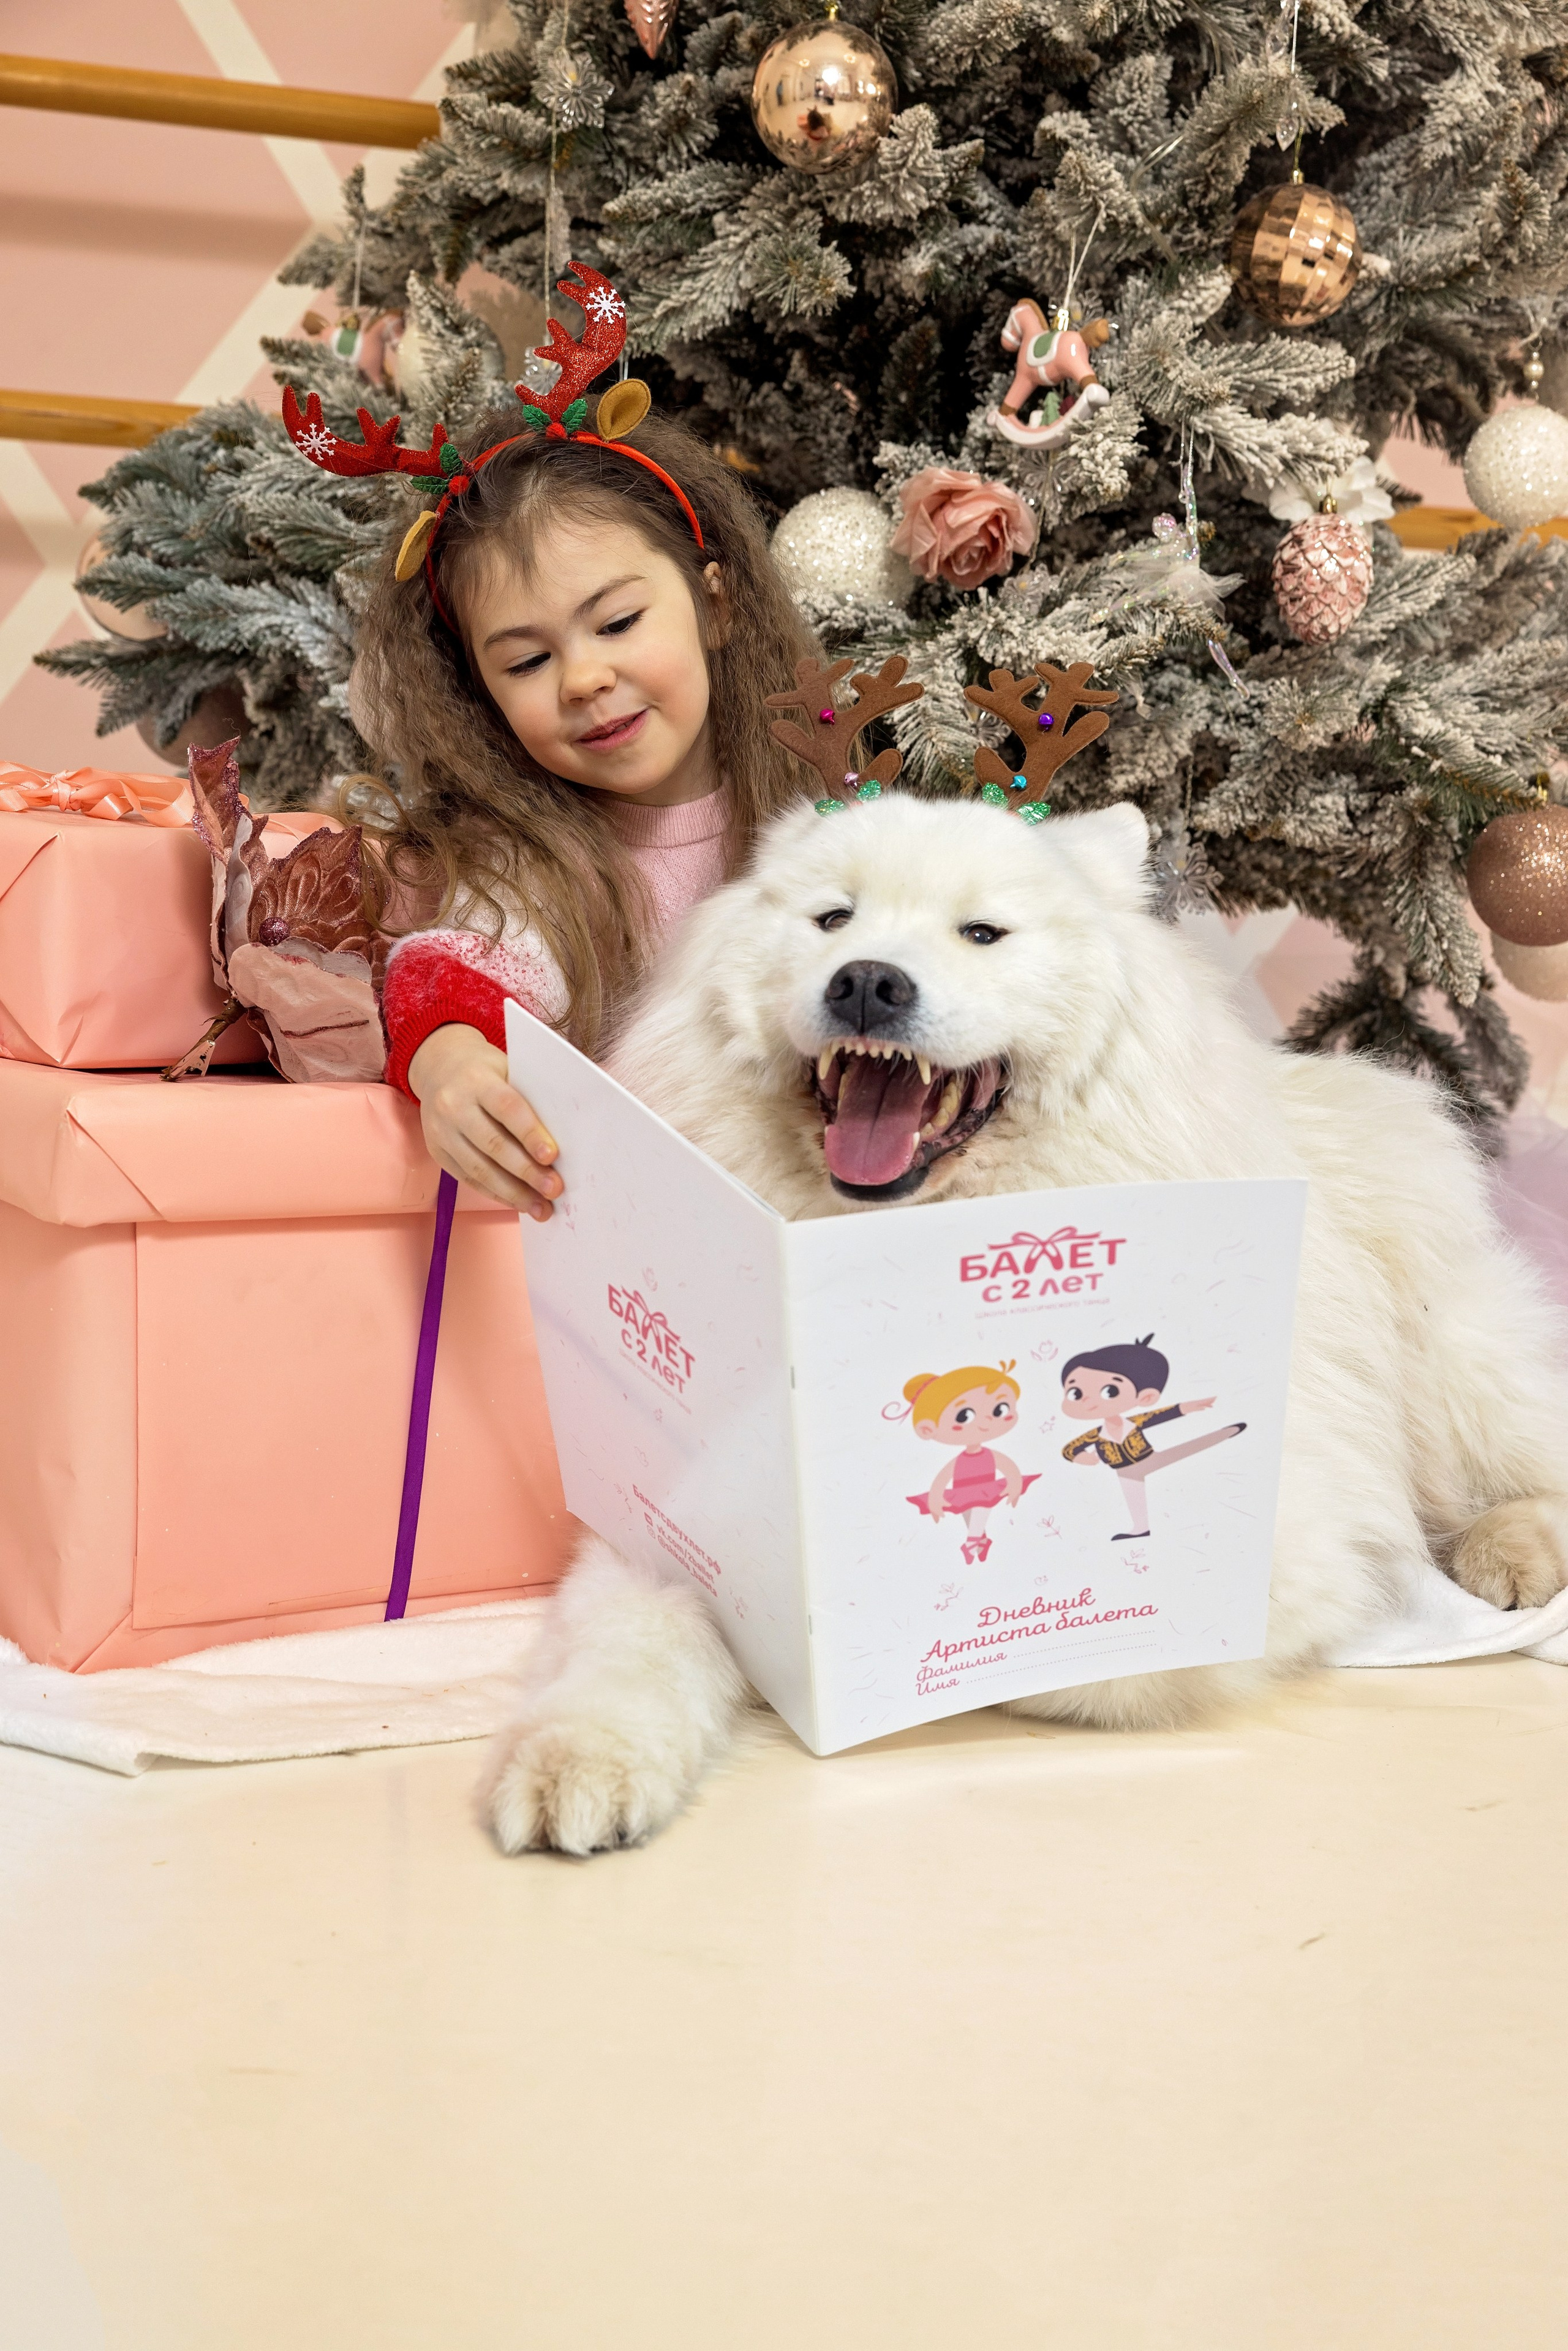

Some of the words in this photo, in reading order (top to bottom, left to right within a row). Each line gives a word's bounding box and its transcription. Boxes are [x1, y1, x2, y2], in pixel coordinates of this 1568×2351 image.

[960, 1226, 1127, 1283] БАЛЕТ
[1011, 1279, 1031, 1299] 2
[1039, 1273, 1104, 1296] лет
[608, 1283, 696, 1379] БАЛЕТ
[636, 1338, 647, 1363] 2
[651, 1354, 686, 1394] лет
[977, 1587, 1096, 1628] Дневник
[920, 1622, 1052, 1662] Артиста
[1055, 1604, 1159, 1631] балета
[915, 1678, 960, 1696] Имя
[916, 1651, 1008, 1683] Фамилия
